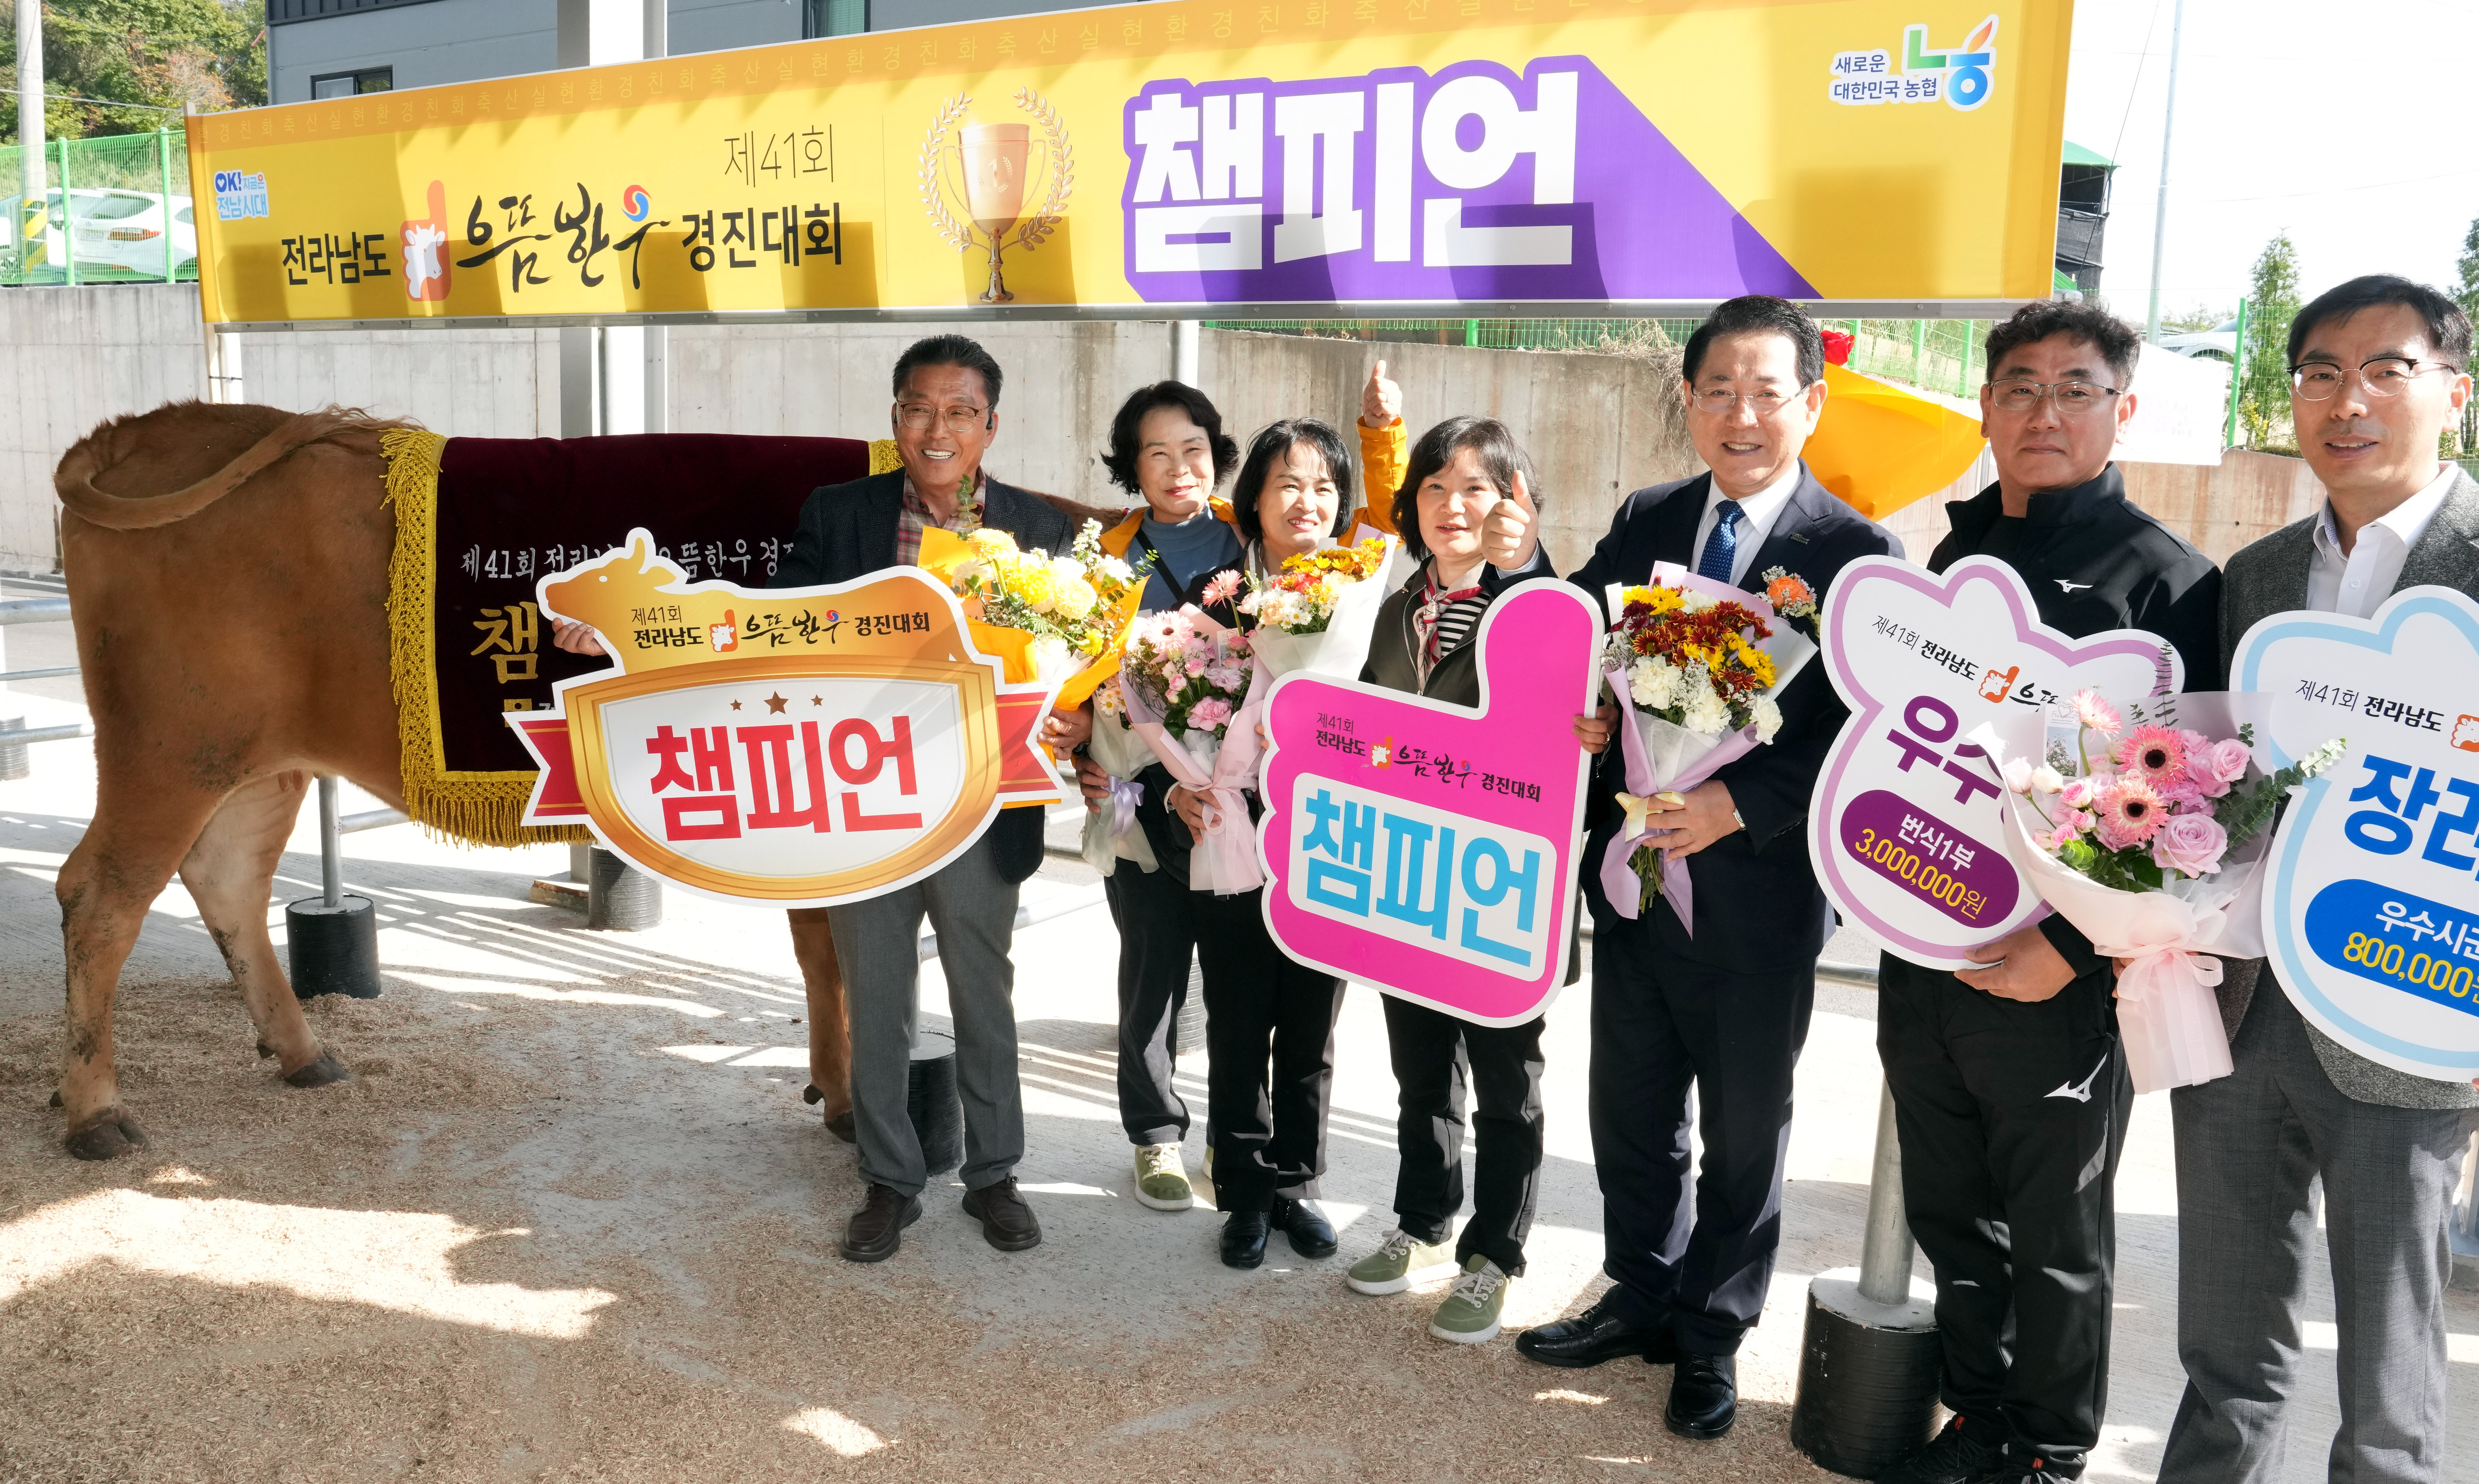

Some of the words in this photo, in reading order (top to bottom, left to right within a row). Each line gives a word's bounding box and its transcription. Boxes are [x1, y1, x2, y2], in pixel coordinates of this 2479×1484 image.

[1834, 80, 1900, 99] 대한민국
[1904, 78, 1937, 98] 농협
[1835, 54, 1885, 74] 새로운
[215, 172, 242, 193] OK!
[242, 174, 265, 190] 지금은
[724, 123, 834, 187] 제41회
[1133, 71, 1578, 273] 챔피언
[281, 231, 391, 285] 전라남도
[681, 202, 842, 272] 경진대회
[460, 544, 535, 583] 제41회
[631, 605, 682, 627] 제41회
[633, 626, 705, 649] 전라남도
[854, 611, 930, 637] 경진대회
[1872, 615, 1921, 651] 제41회
[1920, 638, 1979, 681] 전라남도
[1316, 712, 1354, 735] 제41회
[2294, 679, 2360, 712] 제41회
[2363, 696, 2445, 732] 전라남도
[646, 715, 923, 841] 챔피언
[1315, 730, 1366, 757] 전라남도
[1481, 772, 1541, 803] 경진대회
[1898, 813, 1976, 872] 번식1부
[1302, 788, 1541, 968] 챔피언
[1855, 828, 1988, 920] 3,000,000원
[2343, 931, 2479, 1005] 800,000
